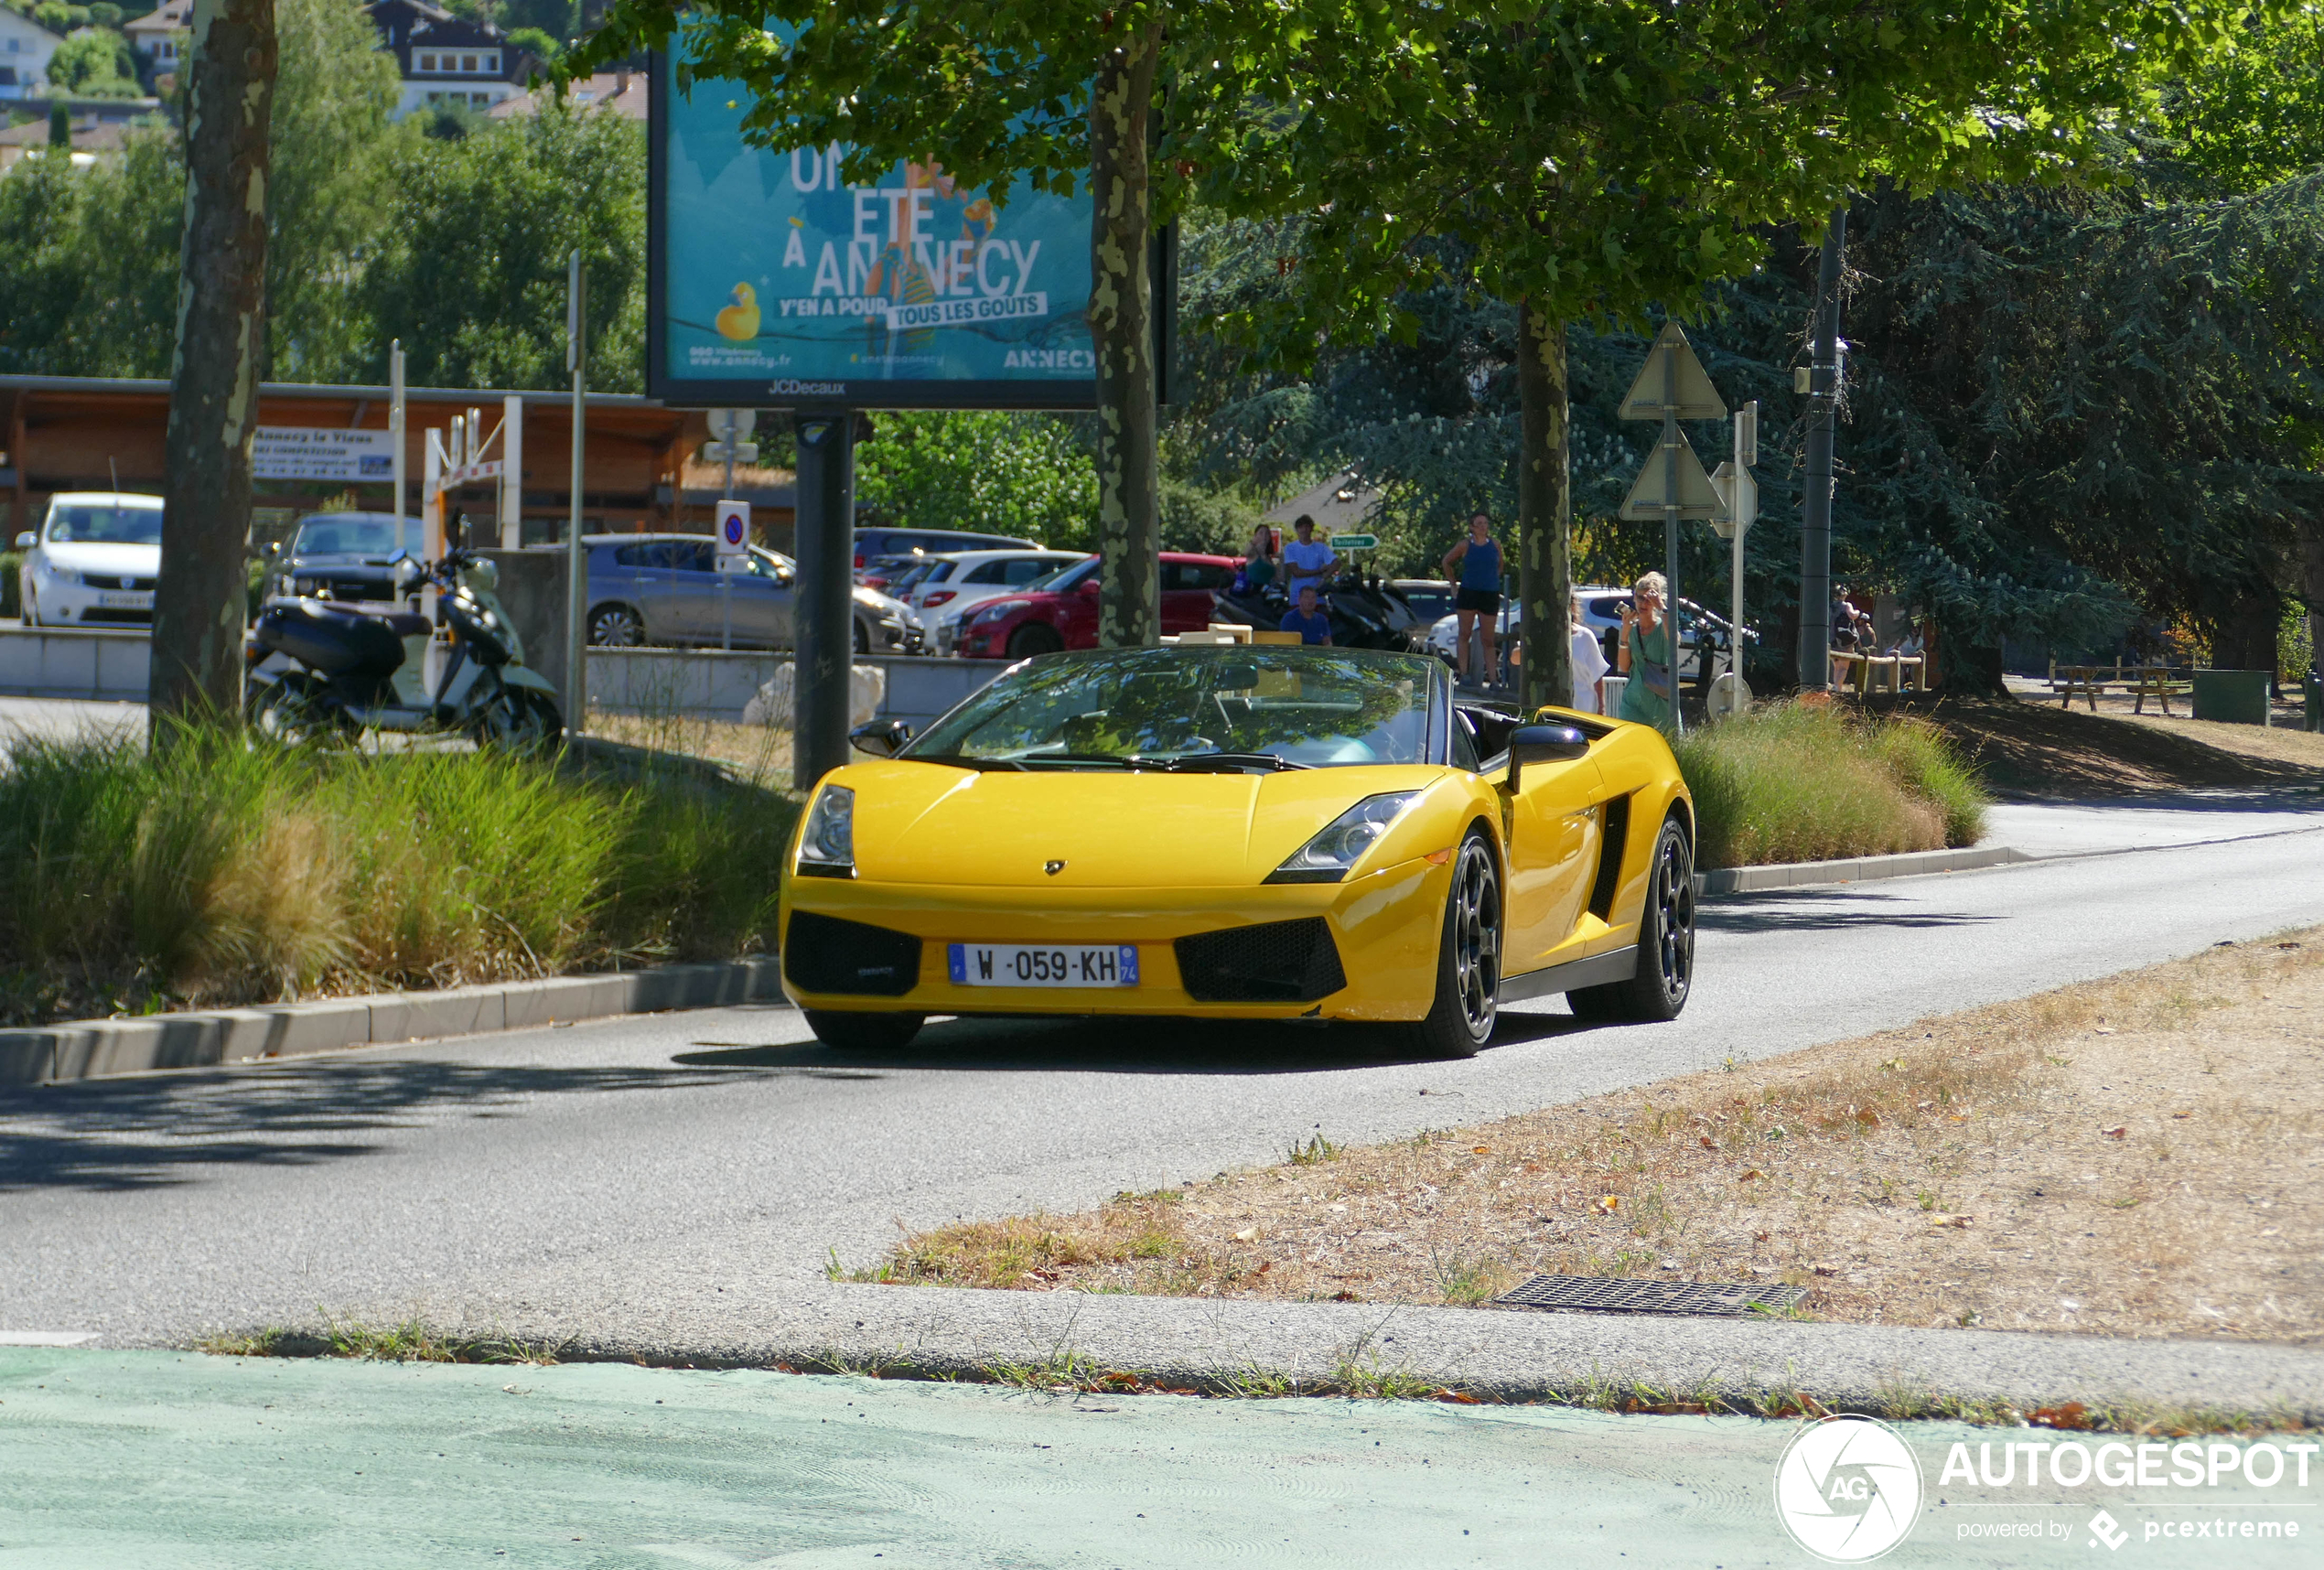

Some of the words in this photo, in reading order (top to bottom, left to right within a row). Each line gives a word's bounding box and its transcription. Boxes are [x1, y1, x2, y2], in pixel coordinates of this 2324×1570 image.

[811, 239, 1041, 298] ANNECY
[822, 298, 835, 317] A
[838, 296, 889, 317] POUR
[895, 302, 941, 327] TOUS
[945, 299, 974, 321] LES
[689, 353, 791, 369] www.annecy.fr
[769, 379, 845, 395] JCDecaux
[1121, 966, 1136, 981] 74
